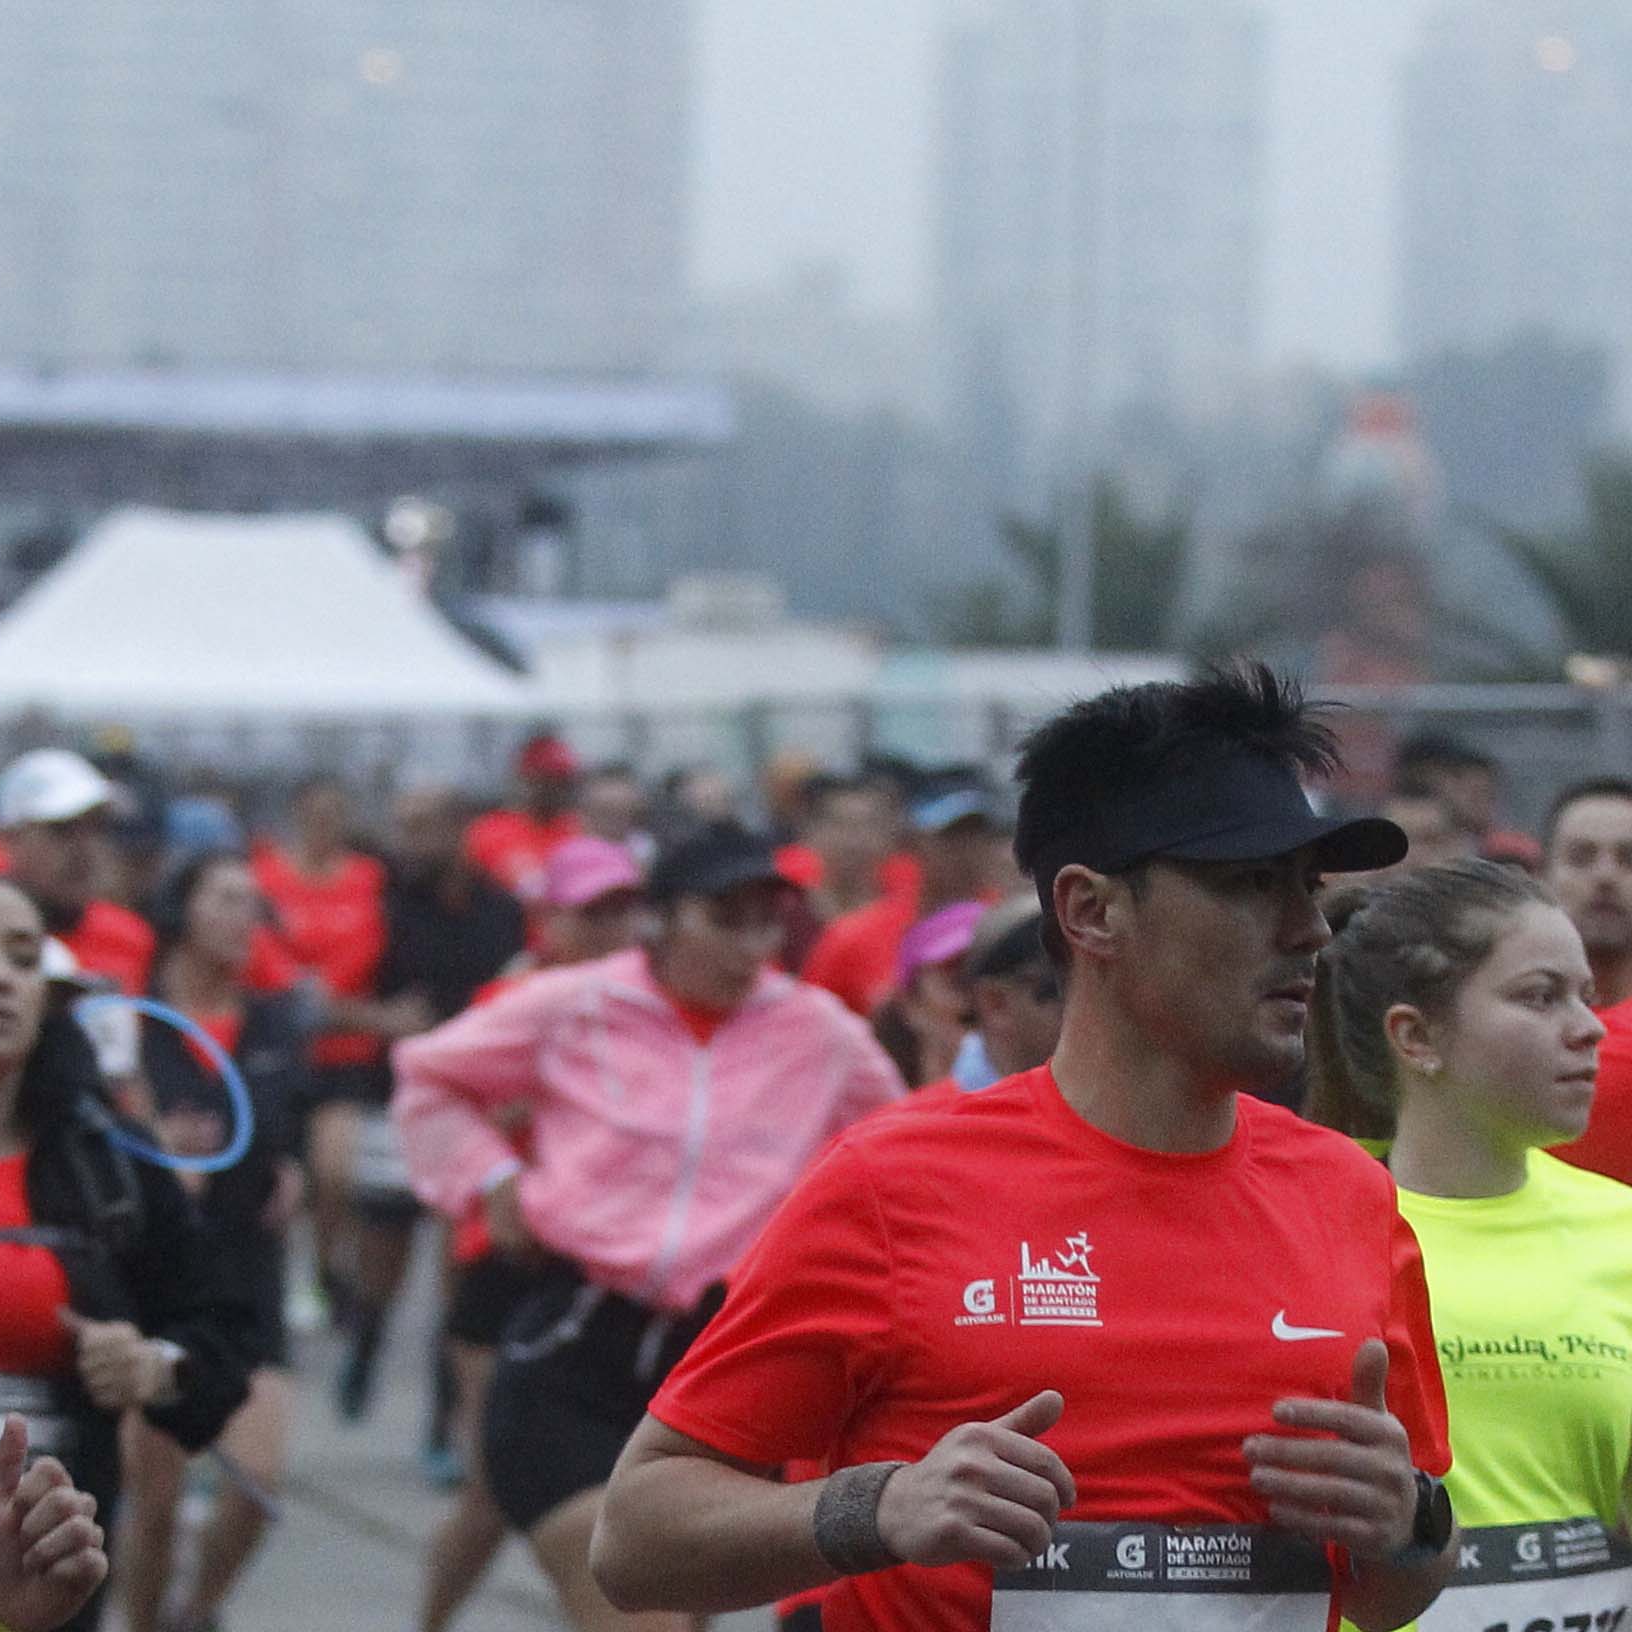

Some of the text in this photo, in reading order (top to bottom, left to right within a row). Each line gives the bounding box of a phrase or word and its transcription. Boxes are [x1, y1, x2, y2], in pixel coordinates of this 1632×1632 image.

[1023, 1282, 1097, 1298] MARATÓN
[1042, 1297, 1097, 1307] SANTIAGO
[1167, 1533, 1252, 1551] MARATÓN
[1167, 1552, 1252, 1567] DE SANTIAGO
